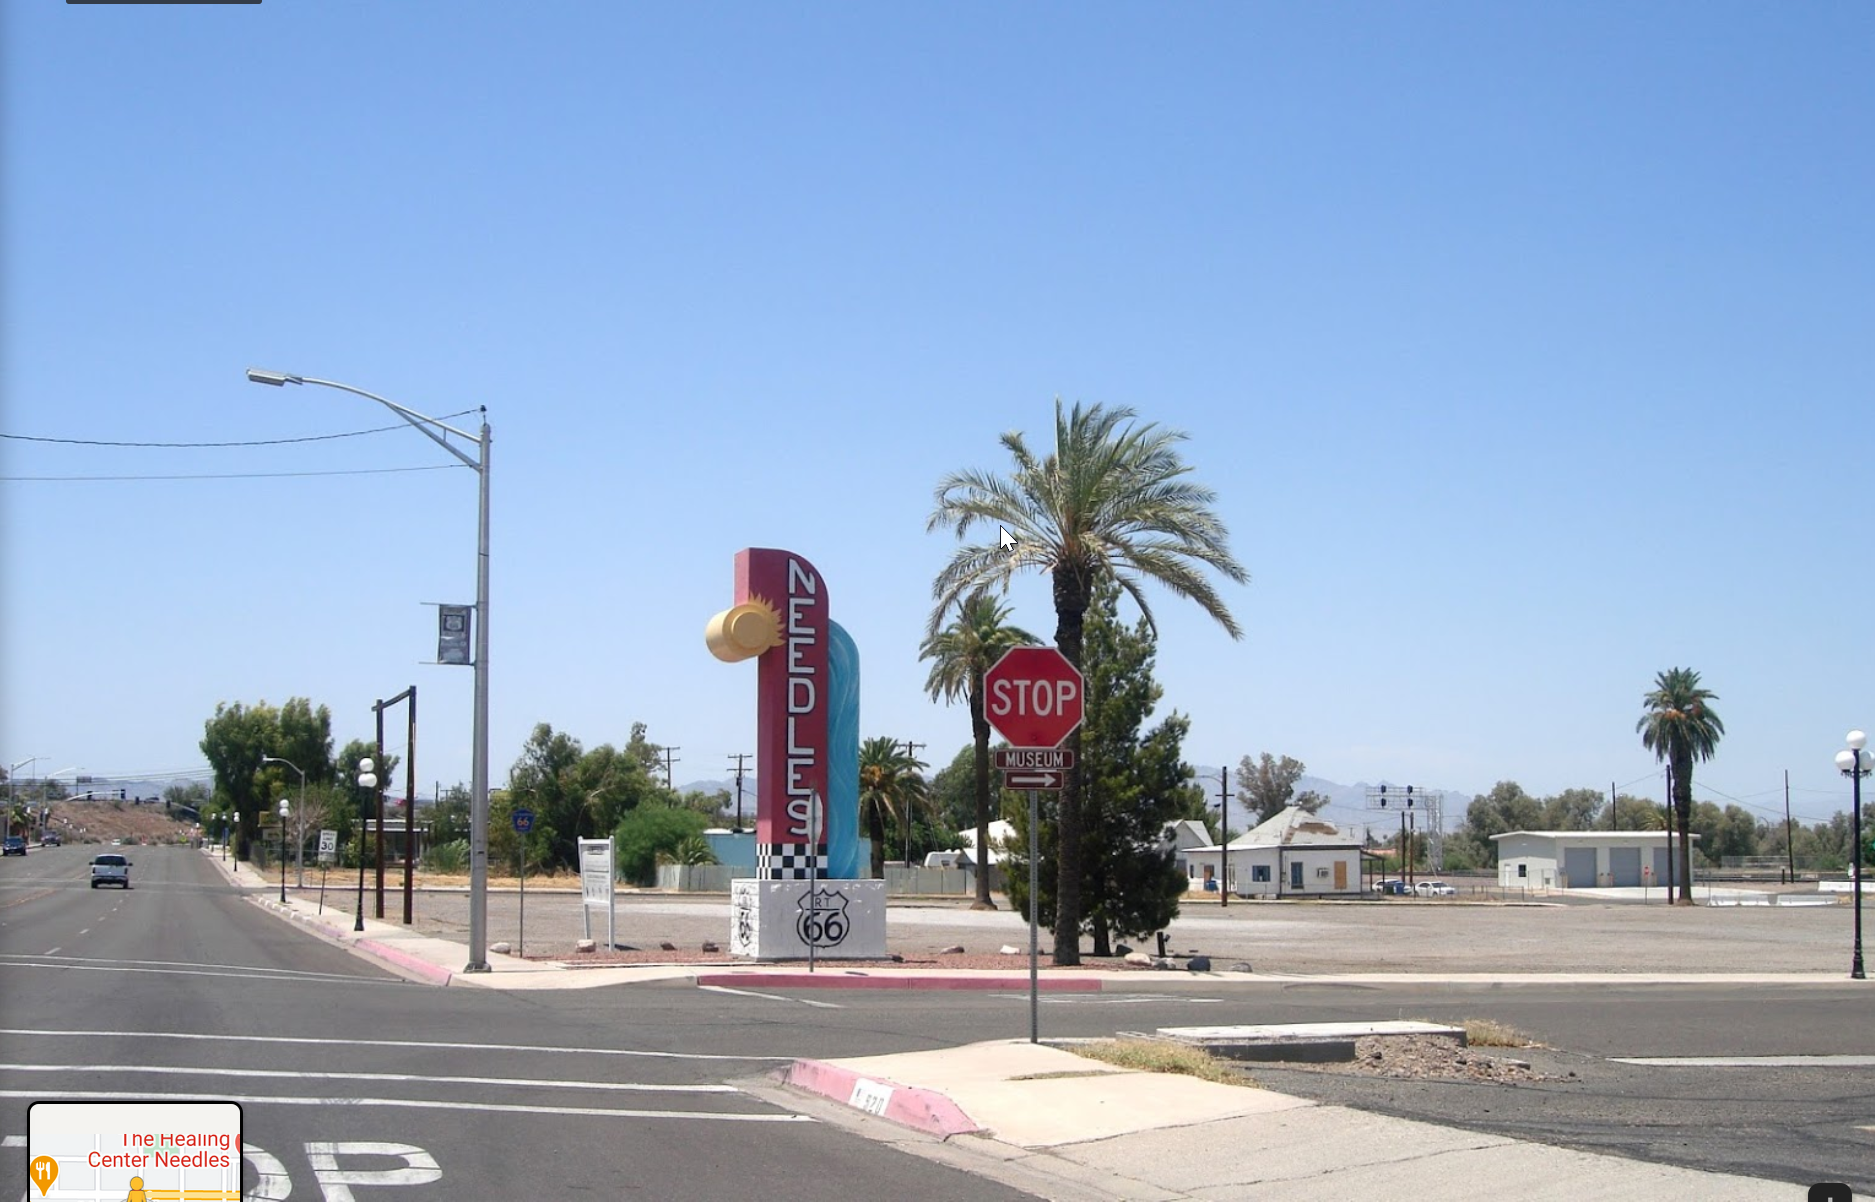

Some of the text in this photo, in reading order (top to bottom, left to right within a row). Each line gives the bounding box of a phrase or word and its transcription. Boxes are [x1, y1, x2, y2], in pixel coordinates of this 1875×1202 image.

[786, 557, 816, 837] NEEDLES
[991, 678, 1078, 717] STOP
[1005, 751, 1064, 768] MUSEUM
[516, 816, 530, 827] 66
[321, 841, 334, 851] 30
[814, 897, 831, 908] RT
[803, 911, 844, 943] 66
